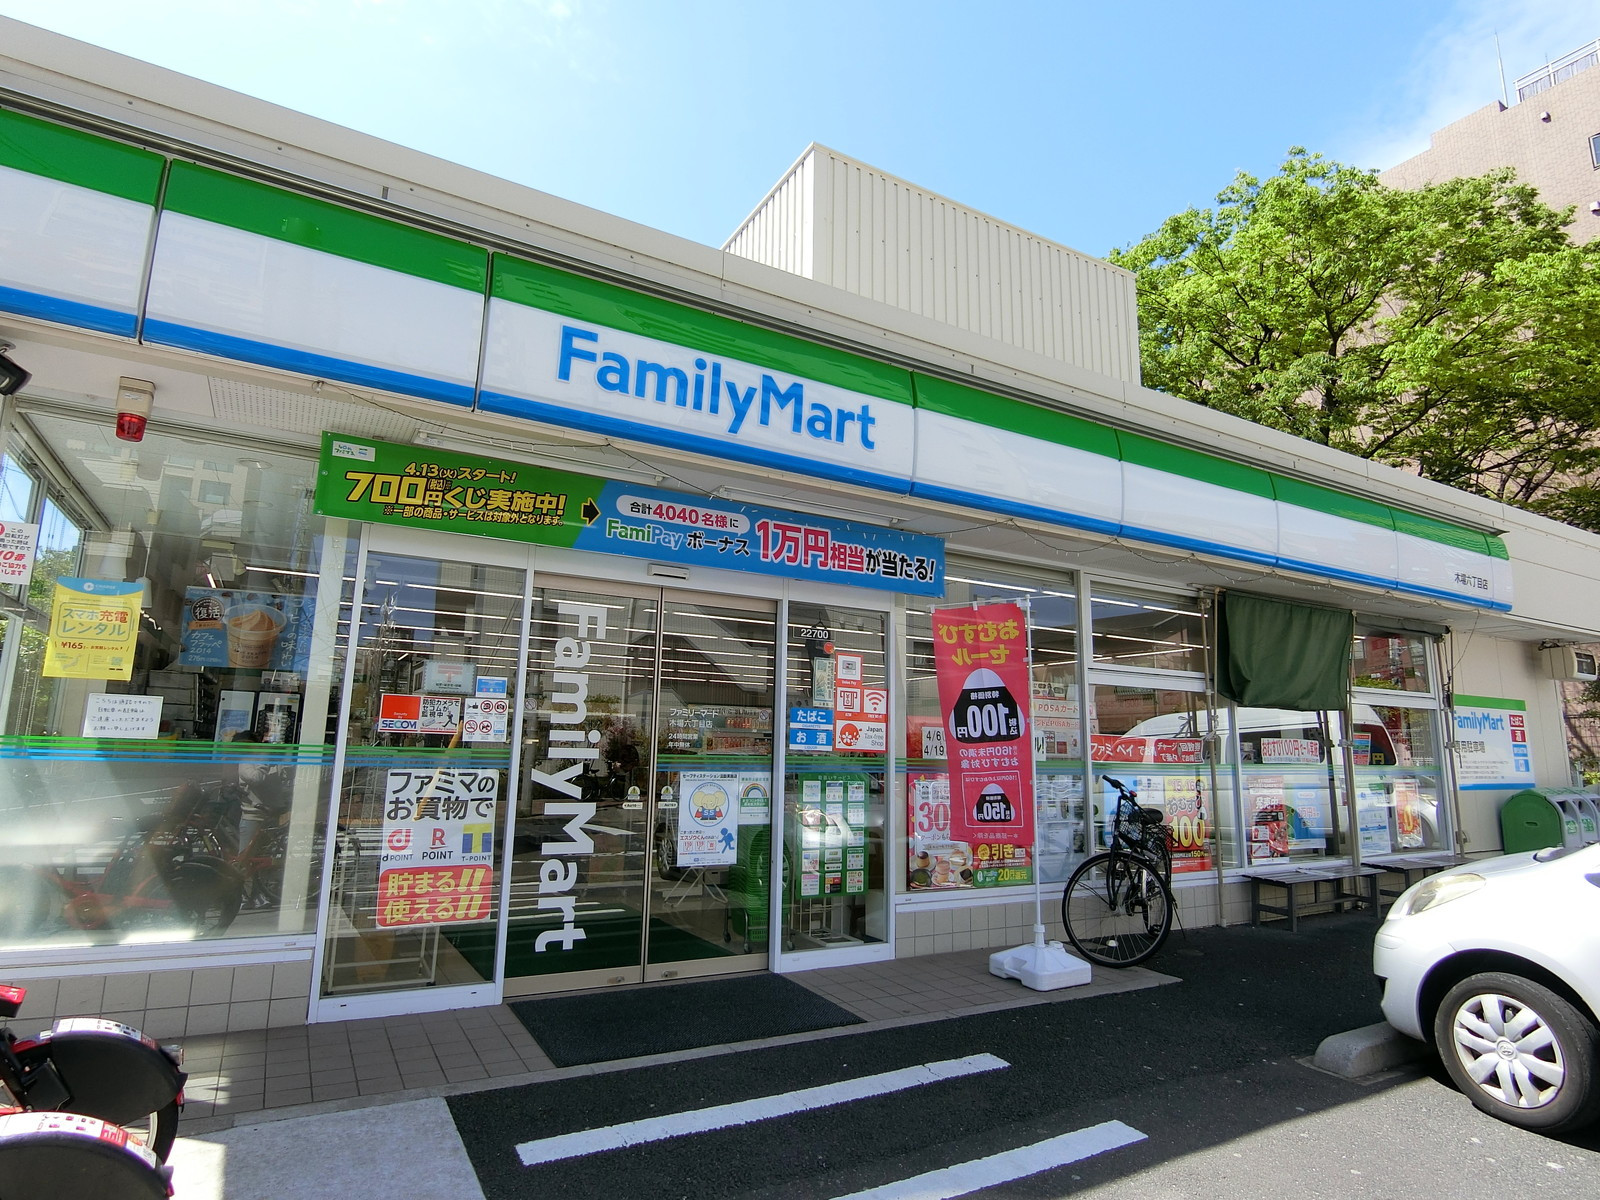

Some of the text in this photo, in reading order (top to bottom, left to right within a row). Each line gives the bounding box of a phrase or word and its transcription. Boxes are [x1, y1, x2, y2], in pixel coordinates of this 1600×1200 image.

[557, 325, 876, 450] FamilyMart
[404, 462, 517, 484] 4.13(火)スタート!
[629, 501, 739, 530] 合計4,040名様に
[606, 518, 751, 557] FamiPay ボーナス
[755, 520, 936, 582] 1万円相当が当たる!
[1454, 572, 1488, 590] 木場六丁目店
[62, 608, 128, 623] スマホ充電
[195, 606, 221, 620] 復活
[61, 621, 126, 636] レンタル
[800, 628, 829, 639] 22700
[422, 698, 460, 707] 防犯カメラで
[1038, 703, 1079, 713] POSAカード
[670, 708, 719, 718] ファミリーマート
[797, 709, 826, 722] たばこ
[381, 719, 417, 730] SECOM
[390, 772, 495, 795] ファミマの
[530, 603, 608, 953] FamilyMart
[386, 796, 494, 821] お買物で
[390, 854, 414, 862] POINT
[422, 851, 454, 861] POINT
[385, 868, 487, 897] 貯まる!!
[384, 894, 484, 924] 使える!!
